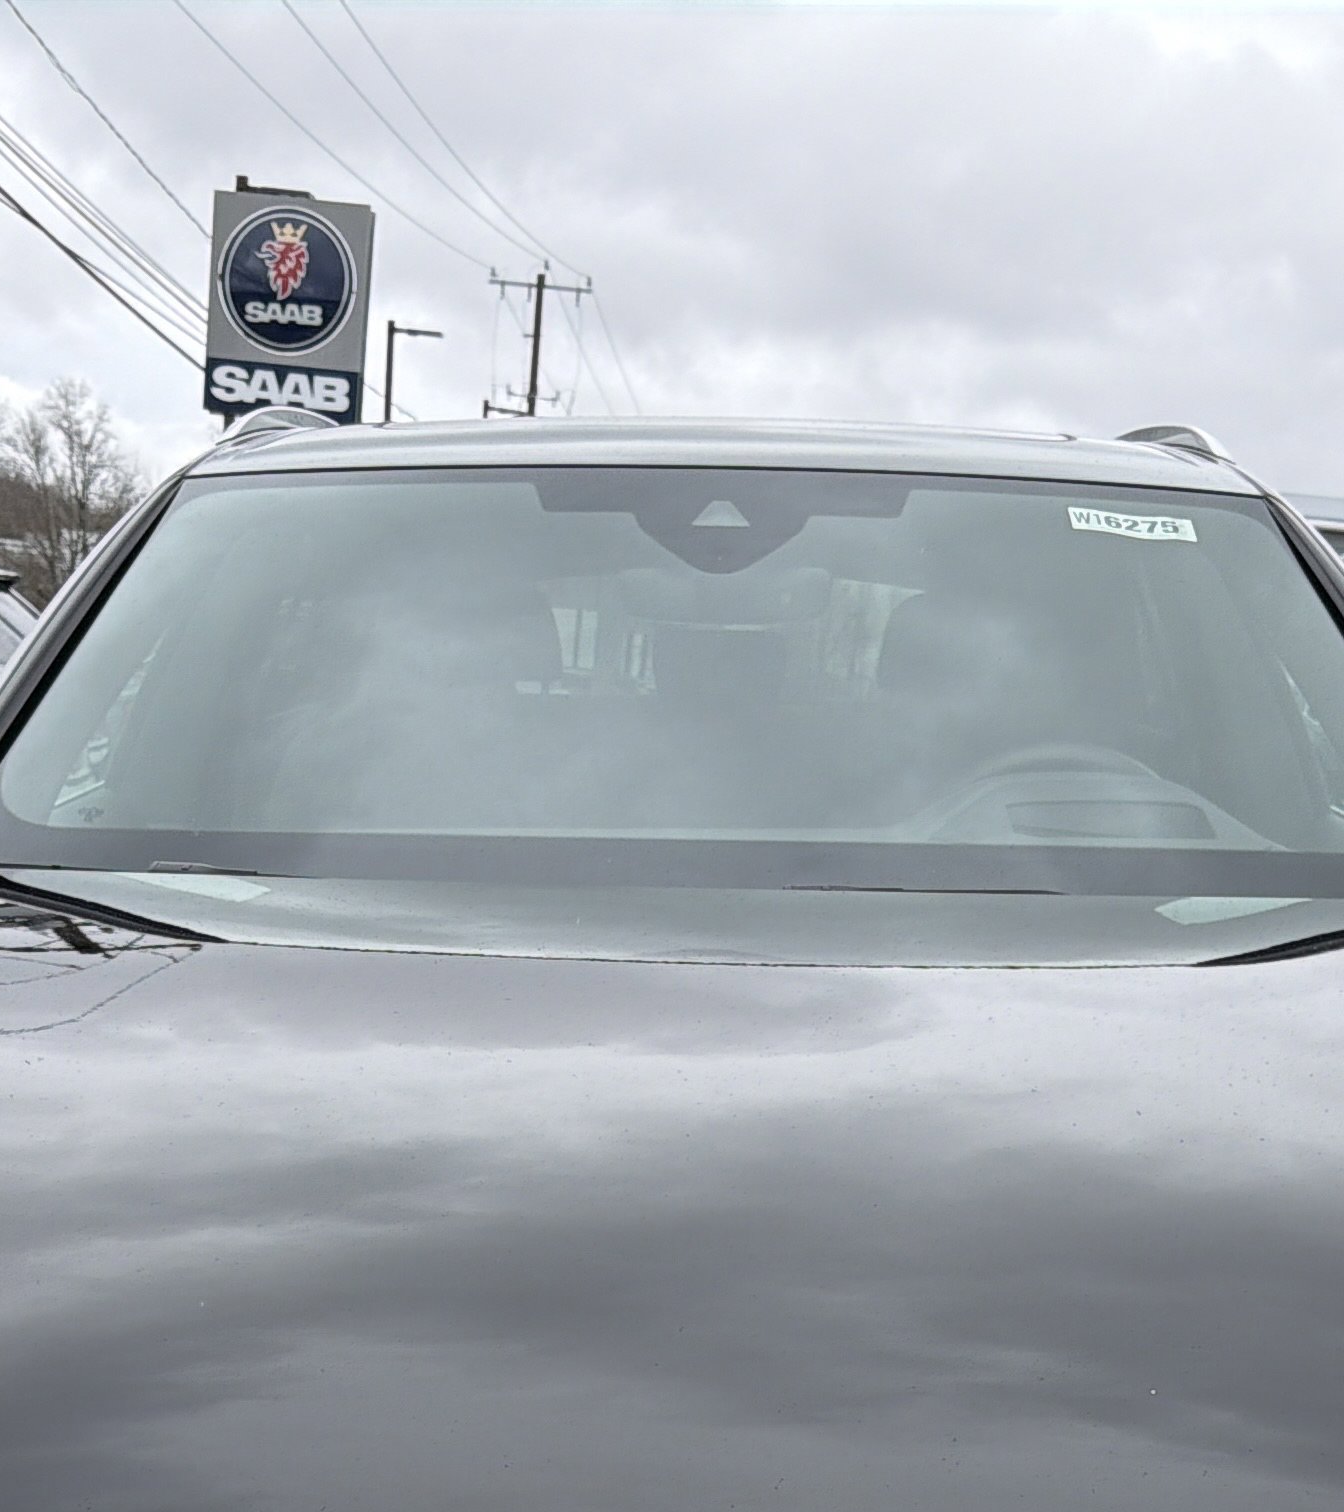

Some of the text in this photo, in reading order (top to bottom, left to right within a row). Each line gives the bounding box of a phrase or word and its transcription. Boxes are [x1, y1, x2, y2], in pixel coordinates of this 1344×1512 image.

[244, 301, 324, 327] SAAB
[209, 364, 351, 413] SAAB
[1072, 511, 1180, 534] W16275
